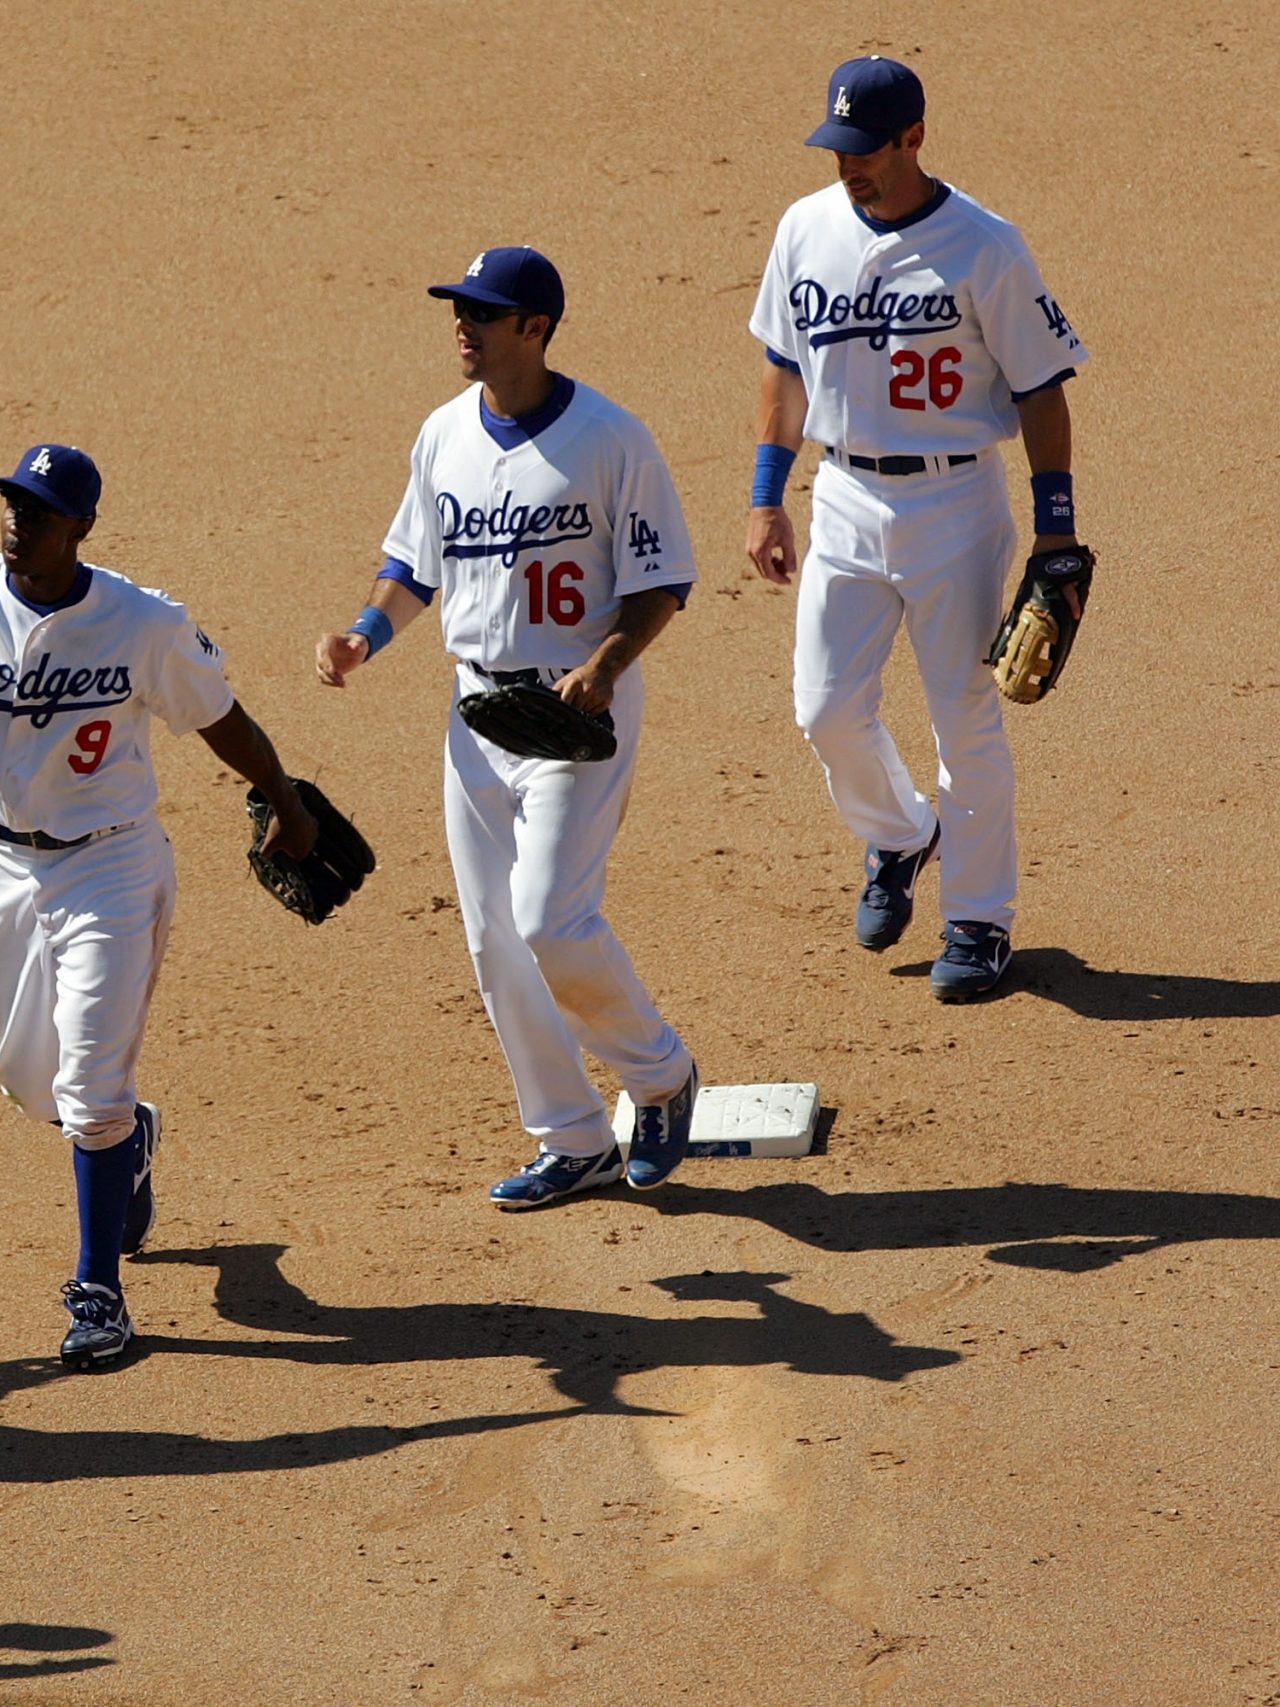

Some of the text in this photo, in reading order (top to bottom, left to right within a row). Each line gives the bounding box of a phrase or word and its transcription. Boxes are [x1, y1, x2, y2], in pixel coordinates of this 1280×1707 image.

[834, 86, 850, 117] LA
[789, 276, 962, 351] Dodgers
[1035, 294, 1072, 338] LA
[889, 346, 963, 411] 26
[30, 448, 52, 476] LA
[436, 490, 593, 569] Dodgers
[629, 512, 662, 557] LA
[1052, 507, 1070, 516] 26
[524, 560, 585, 626] 16
[68, 720, 112, 774] 9
